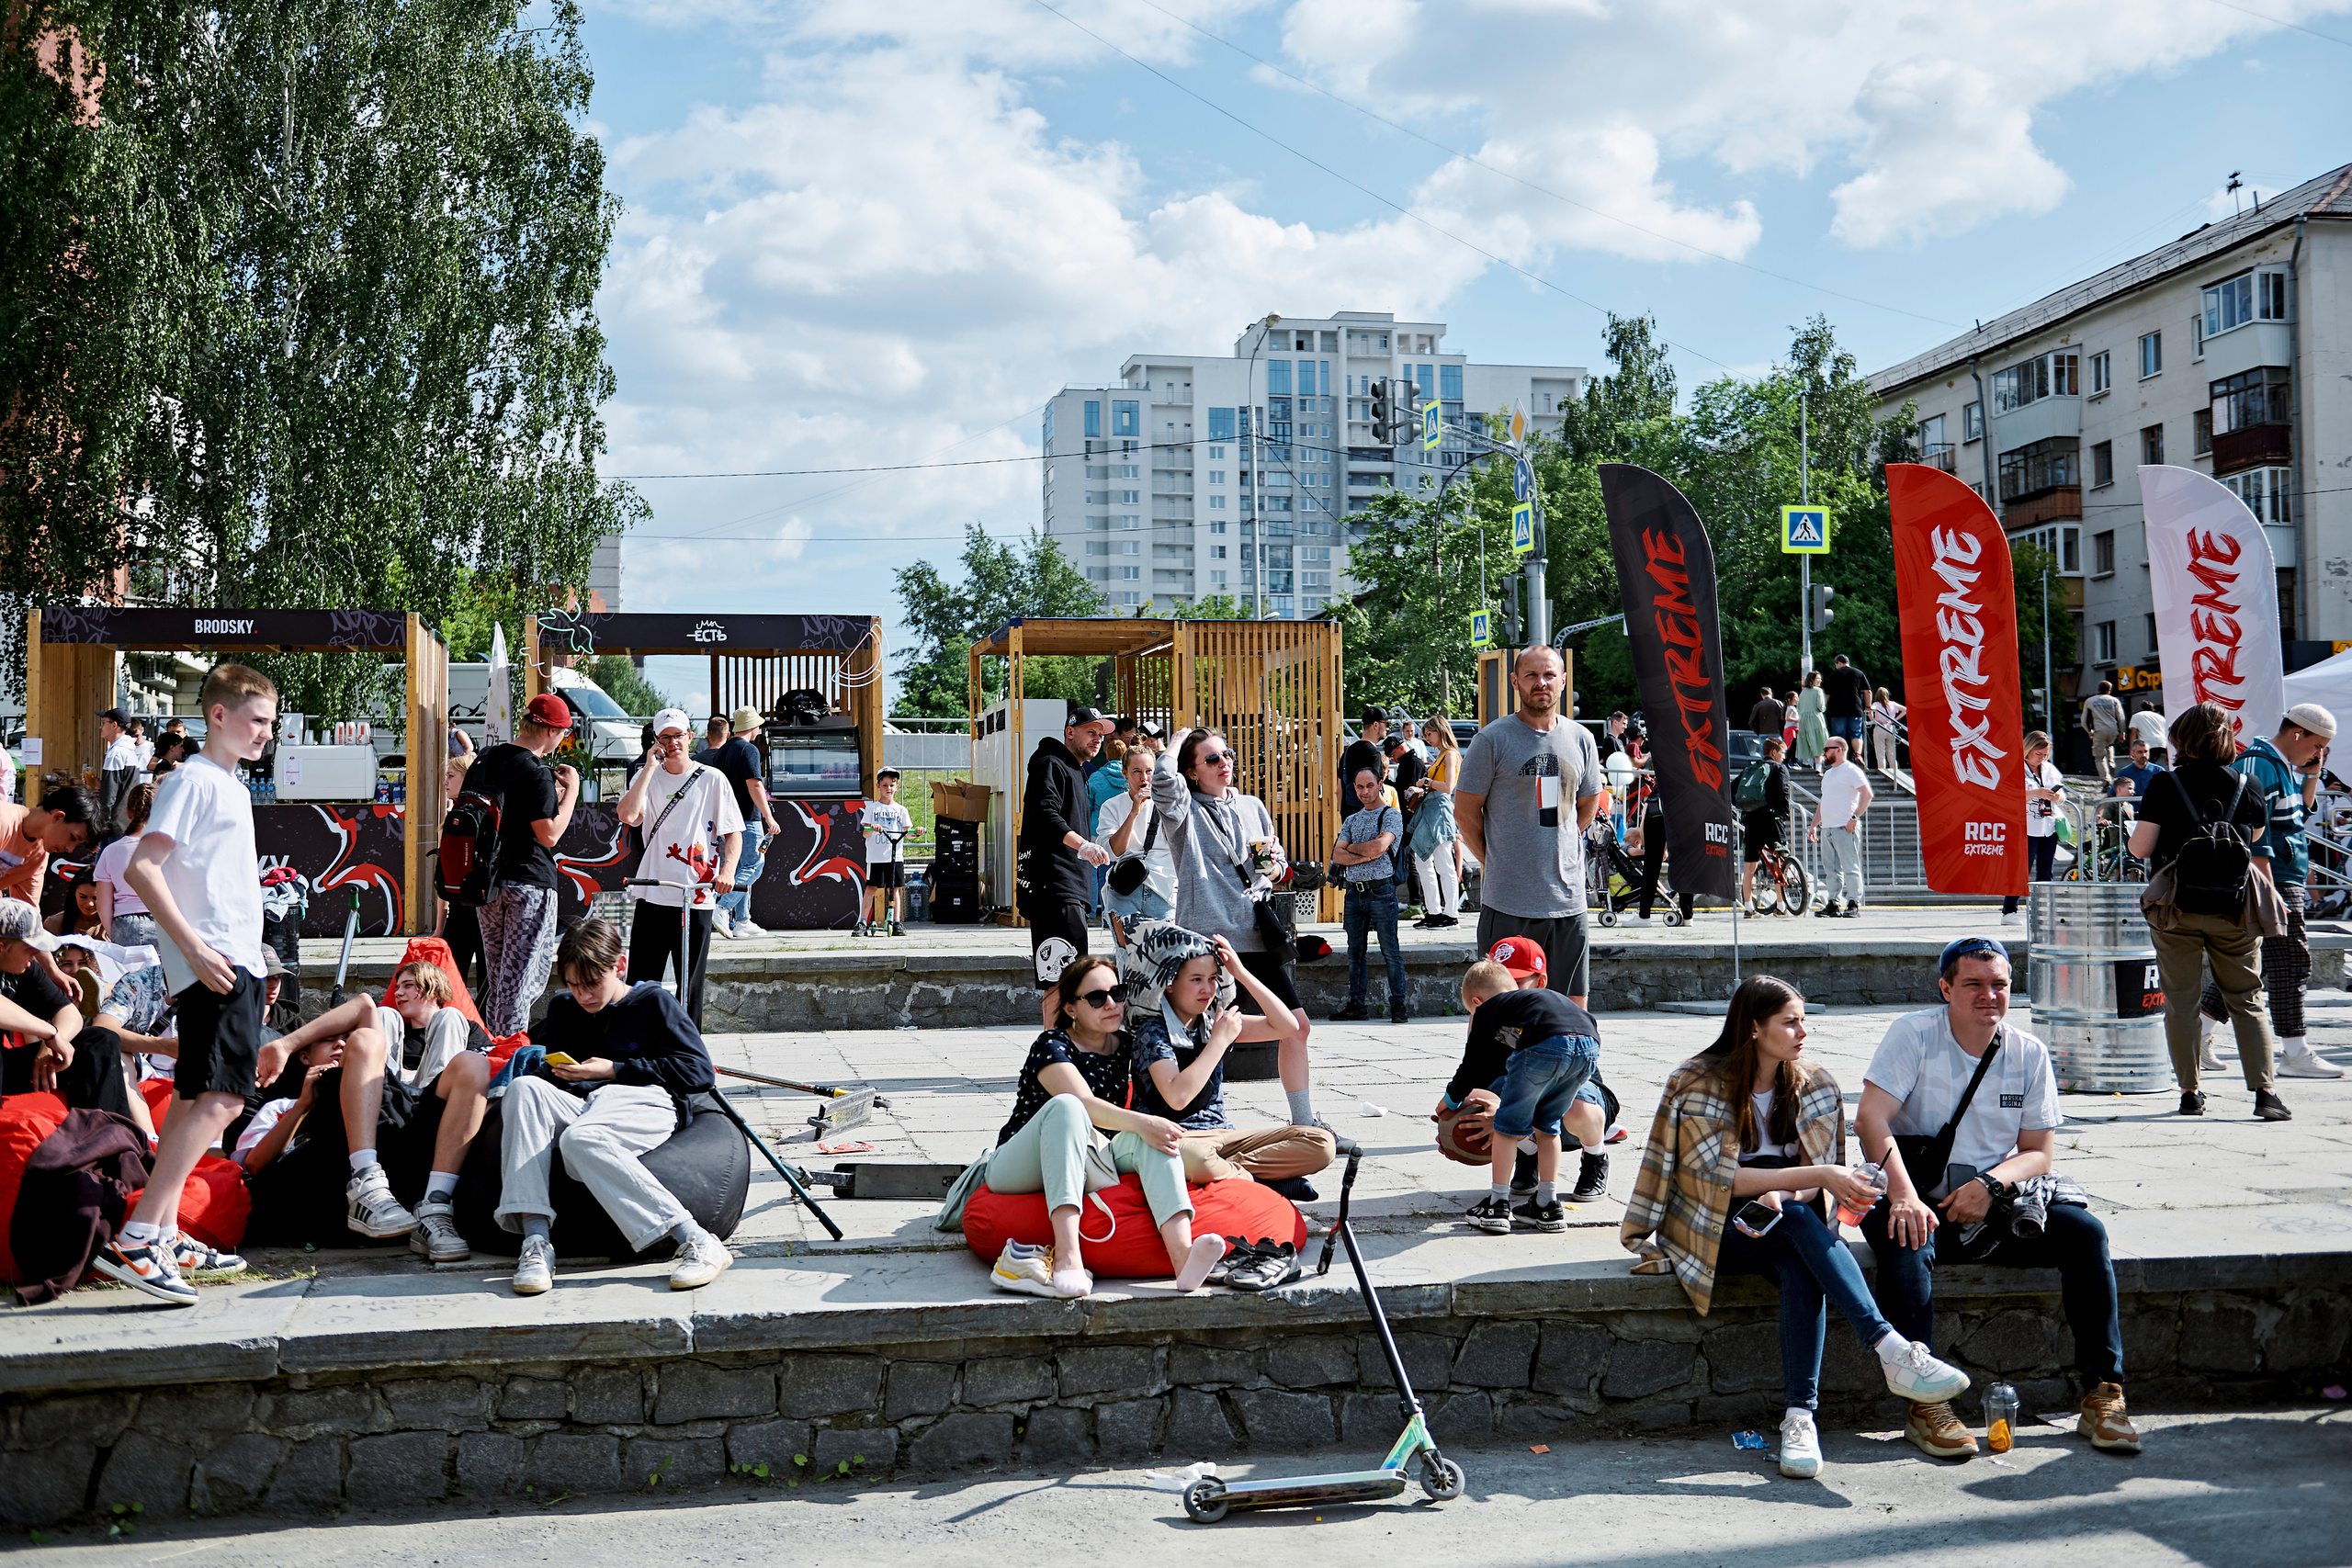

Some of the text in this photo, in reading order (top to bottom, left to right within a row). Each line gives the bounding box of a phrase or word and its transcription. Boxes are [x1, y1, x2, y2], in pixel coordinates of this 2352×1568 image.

[2187, 526, 2247, 755] TREME
[1642, 526, 1723, 793] EXTREME
[1931, 525, 2007, 790] EXTREME
[2136, 671, 2162, 690] Стр
[1705, 822, 1728, 844] RCC
[1965, 822, 2007, 841] RCC
[1705, 844, 1727, 858] EXTREME
[1964, 843, 2005, 856] EXTREME
[2142, 992, 2166, 1010] EXTR
